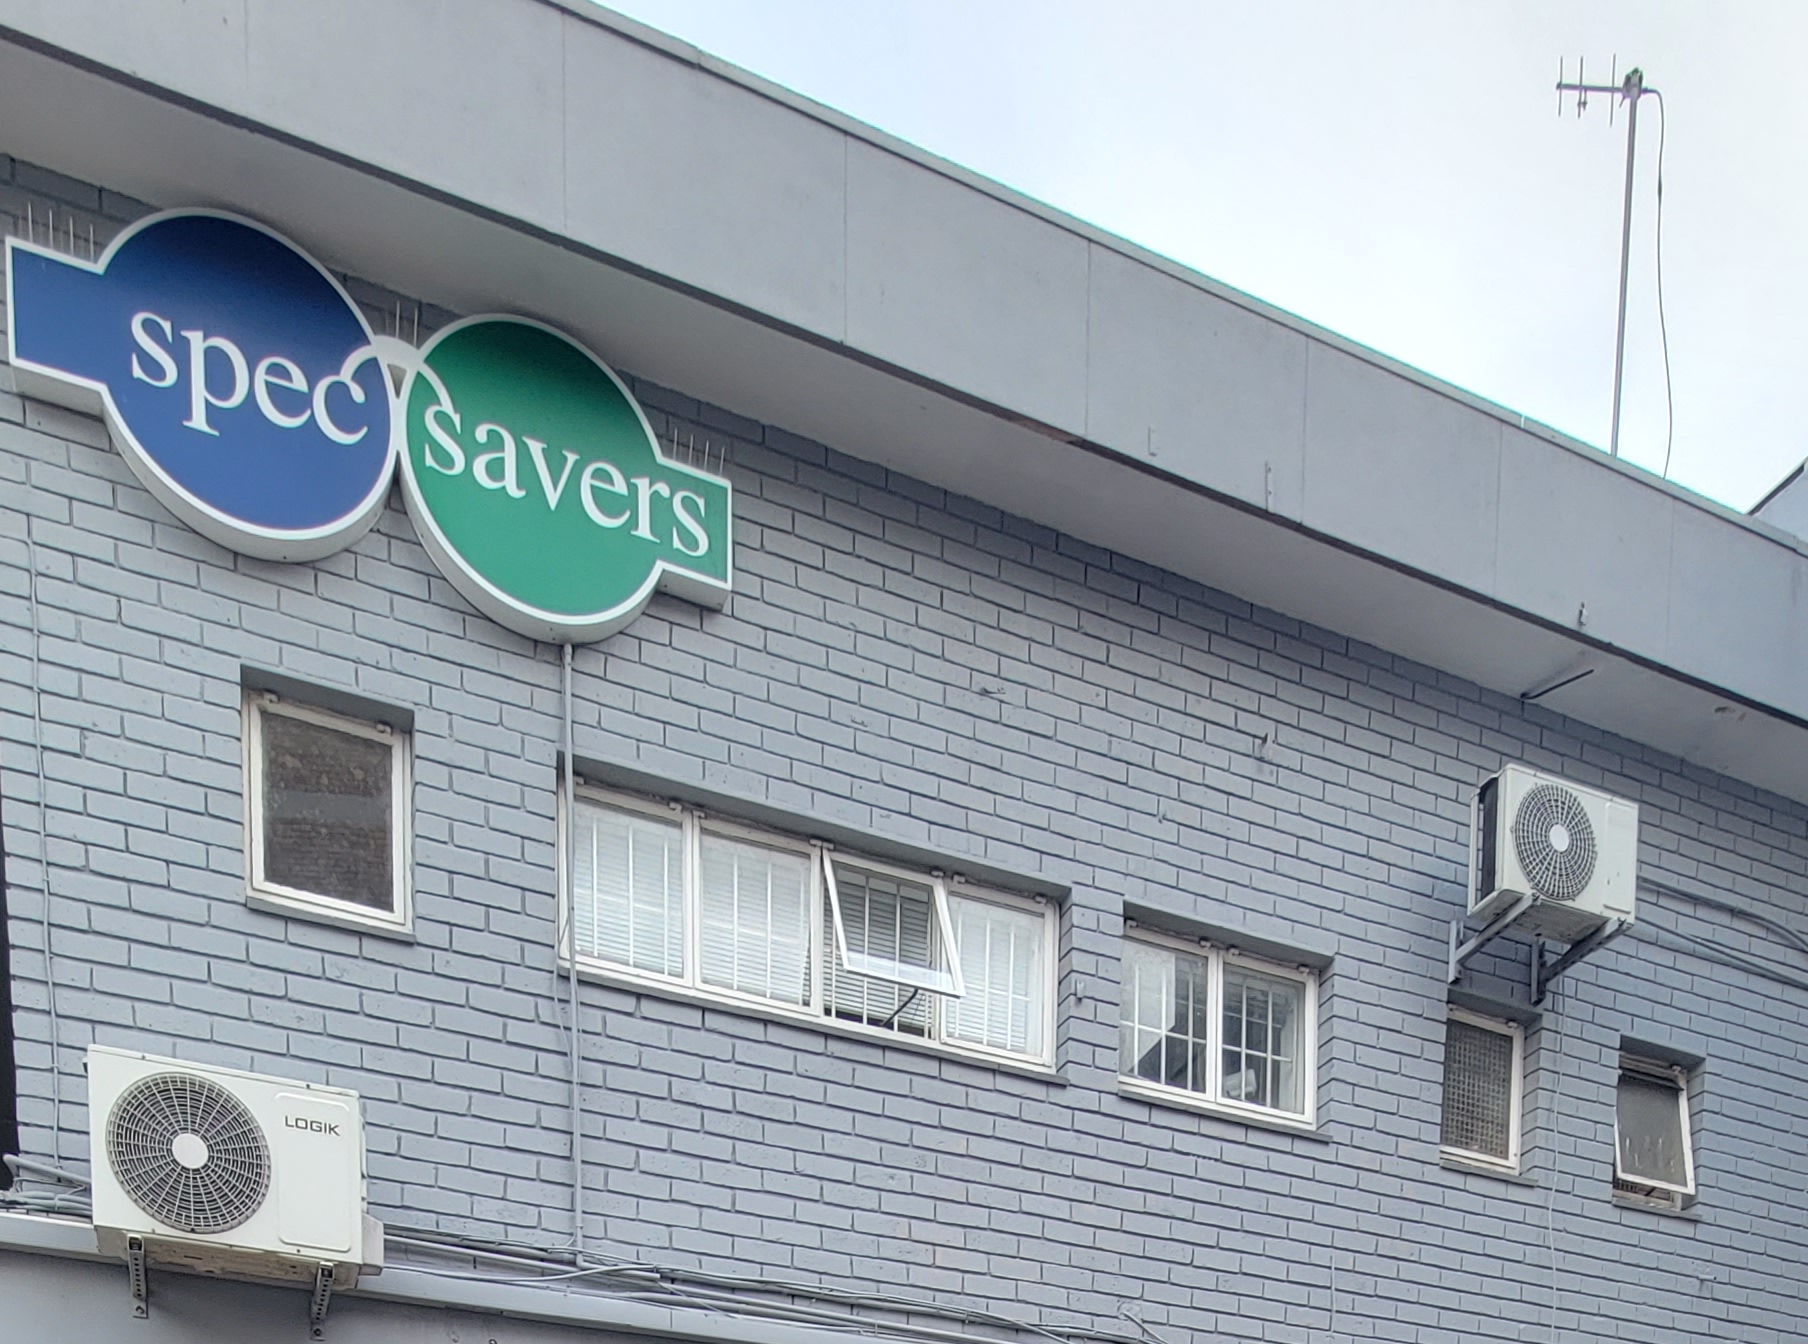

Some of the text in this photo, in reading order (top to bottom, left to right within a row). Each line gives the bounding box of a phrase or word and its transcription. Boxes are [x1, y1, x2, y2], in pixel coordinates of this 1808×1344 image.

[130, 311, 369, 445] spec
[423, 404, 710, 557] savers
[284, 1114, 341, 1137] LOGIK
